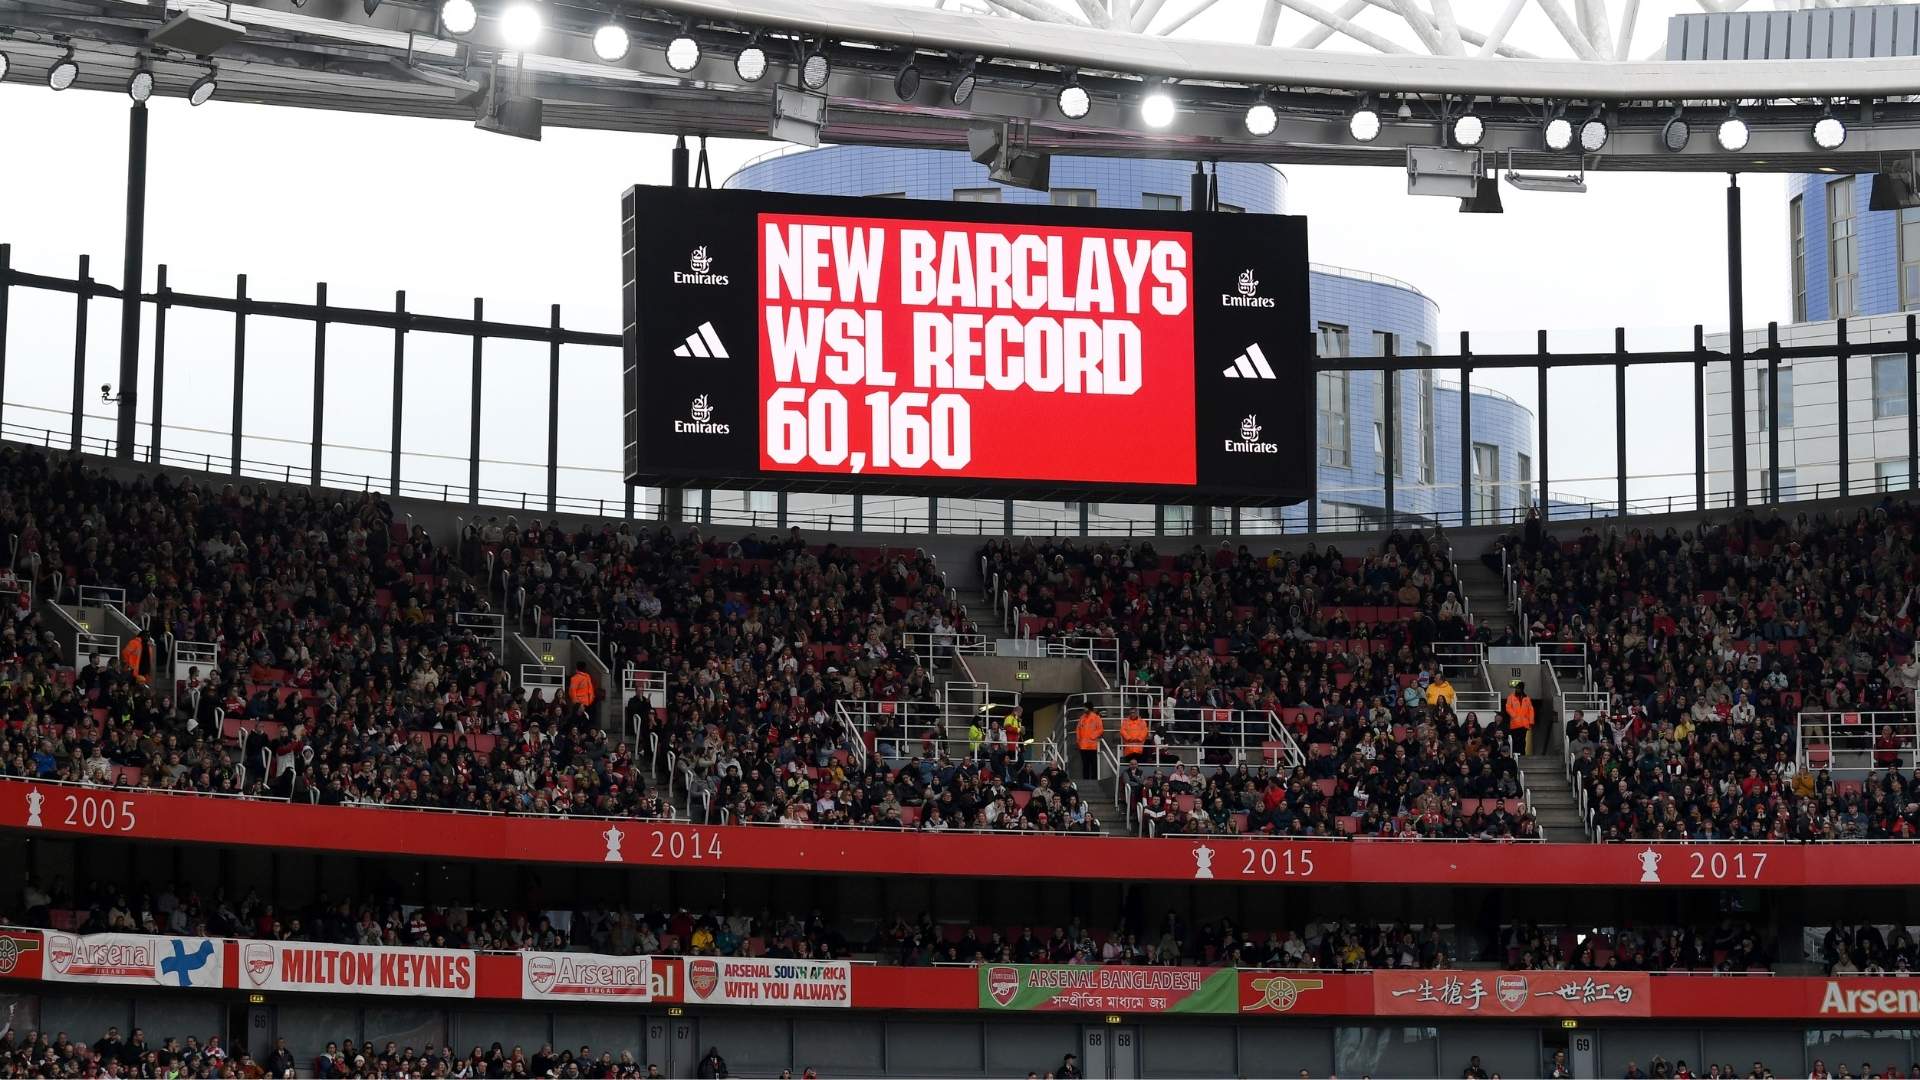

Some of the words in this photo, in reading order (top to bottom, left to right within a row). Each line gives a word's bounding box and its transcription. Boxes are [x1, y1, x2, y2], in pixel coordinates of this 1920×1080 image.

[674, 271, 729, 285] Emirates
[765, 223, 885, 302] NEW
[900, 228, 1187, 315] BARCLAYS
[1222, 294, 1275, 307] Emirates
[765, 306, 896, 386] WSL
[914, 311, 1142, 395] RECORD
[675, 420, 730, 434] Emirates
[766, 388, 971, 474] 60,160
[1225, 439, 1278, 453] Emirates
[64, 795, 136, 831] 2005
[650, 830, 723, 860] 2014
[1241, 848, 1314, 876] 2015
[1690, 852, 1768, 879] 2017
[72, 937, 155, 966] Arsenal
[281, 949, 373, 986] MILTON
[380, 953, 471, 990] KEYNES
[557, 957, 647, 985] Arsenal
[724, 963, 772, 978] ARSENAL
[774, 965, 807, 980] SOUTH
[810, 966, 846, 980] AFRICA
[1027, 968, 1098, 989] ARSENAL
[1100, 969, 1201, 991] BANGLADESH
[724, 981, 759, 999] WITH
[762, 983, 789, 1000] YOU
[793, 984, 847, 1001] ALWAYS
[1391, 975, 1488, 1010] 一生槍手
[1534, 977, 1633, 1004] 一世紅白
[1820, 980, 1920, 1014] Arsen
[651, 1026, 663, 1039] 67
[678, 1026, 689, 1040] 67
[1089, 1033, 1102, 1047] 68
[1118, 1033, 1131, 1047] 68
[1576, 1038, 1590, 1051] 69
